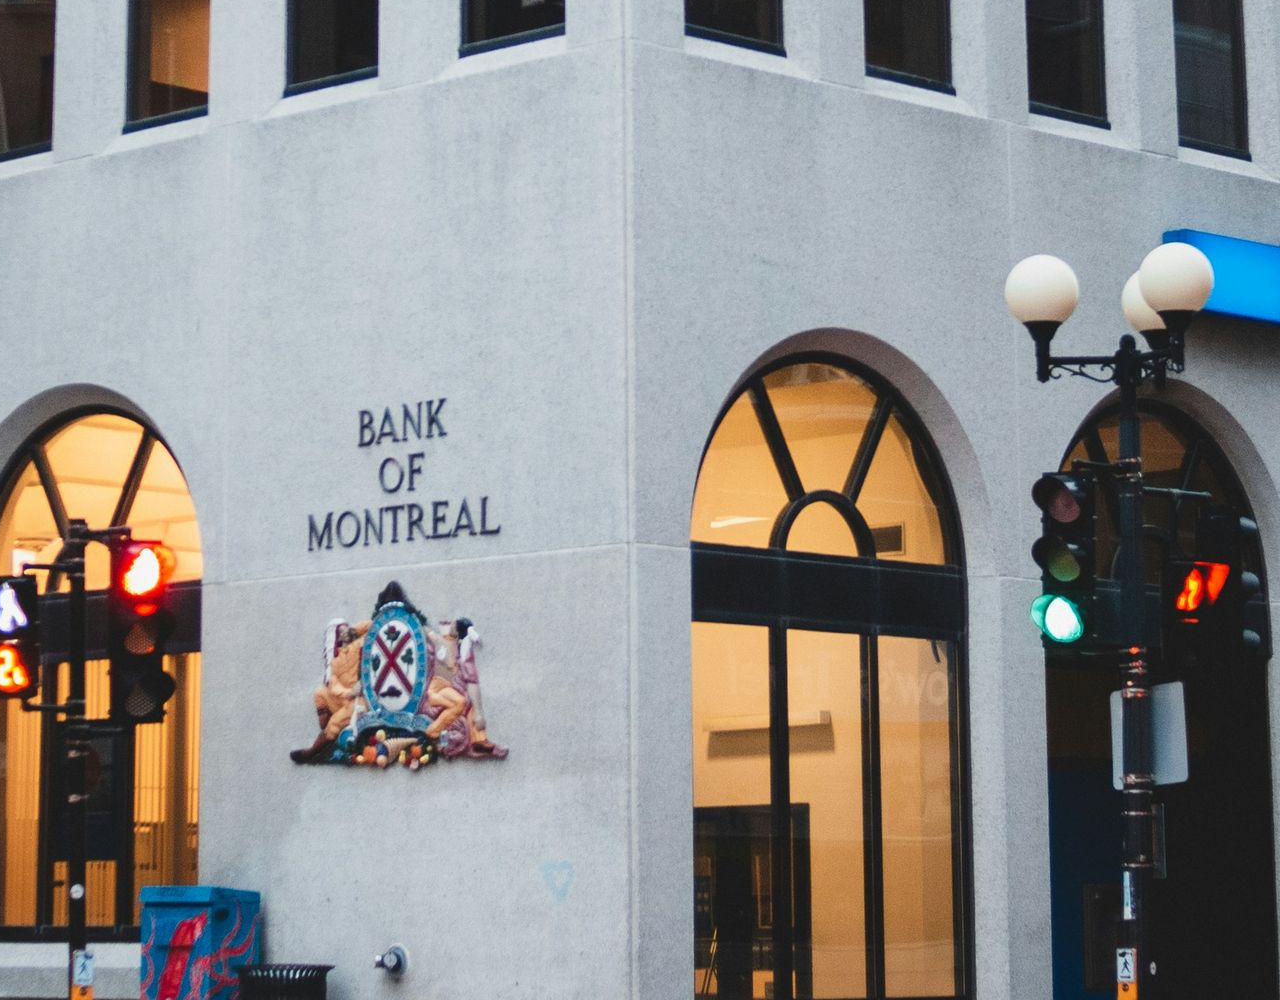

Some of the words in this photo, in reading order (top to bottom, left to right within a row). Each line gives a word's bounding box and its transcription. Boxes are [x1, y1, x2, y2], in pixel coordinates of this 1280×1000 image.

[357, 398, 449, 448] BANK
[378, 452, 426, 494] OF
[306, 496, 502, 553] MONTREAL
